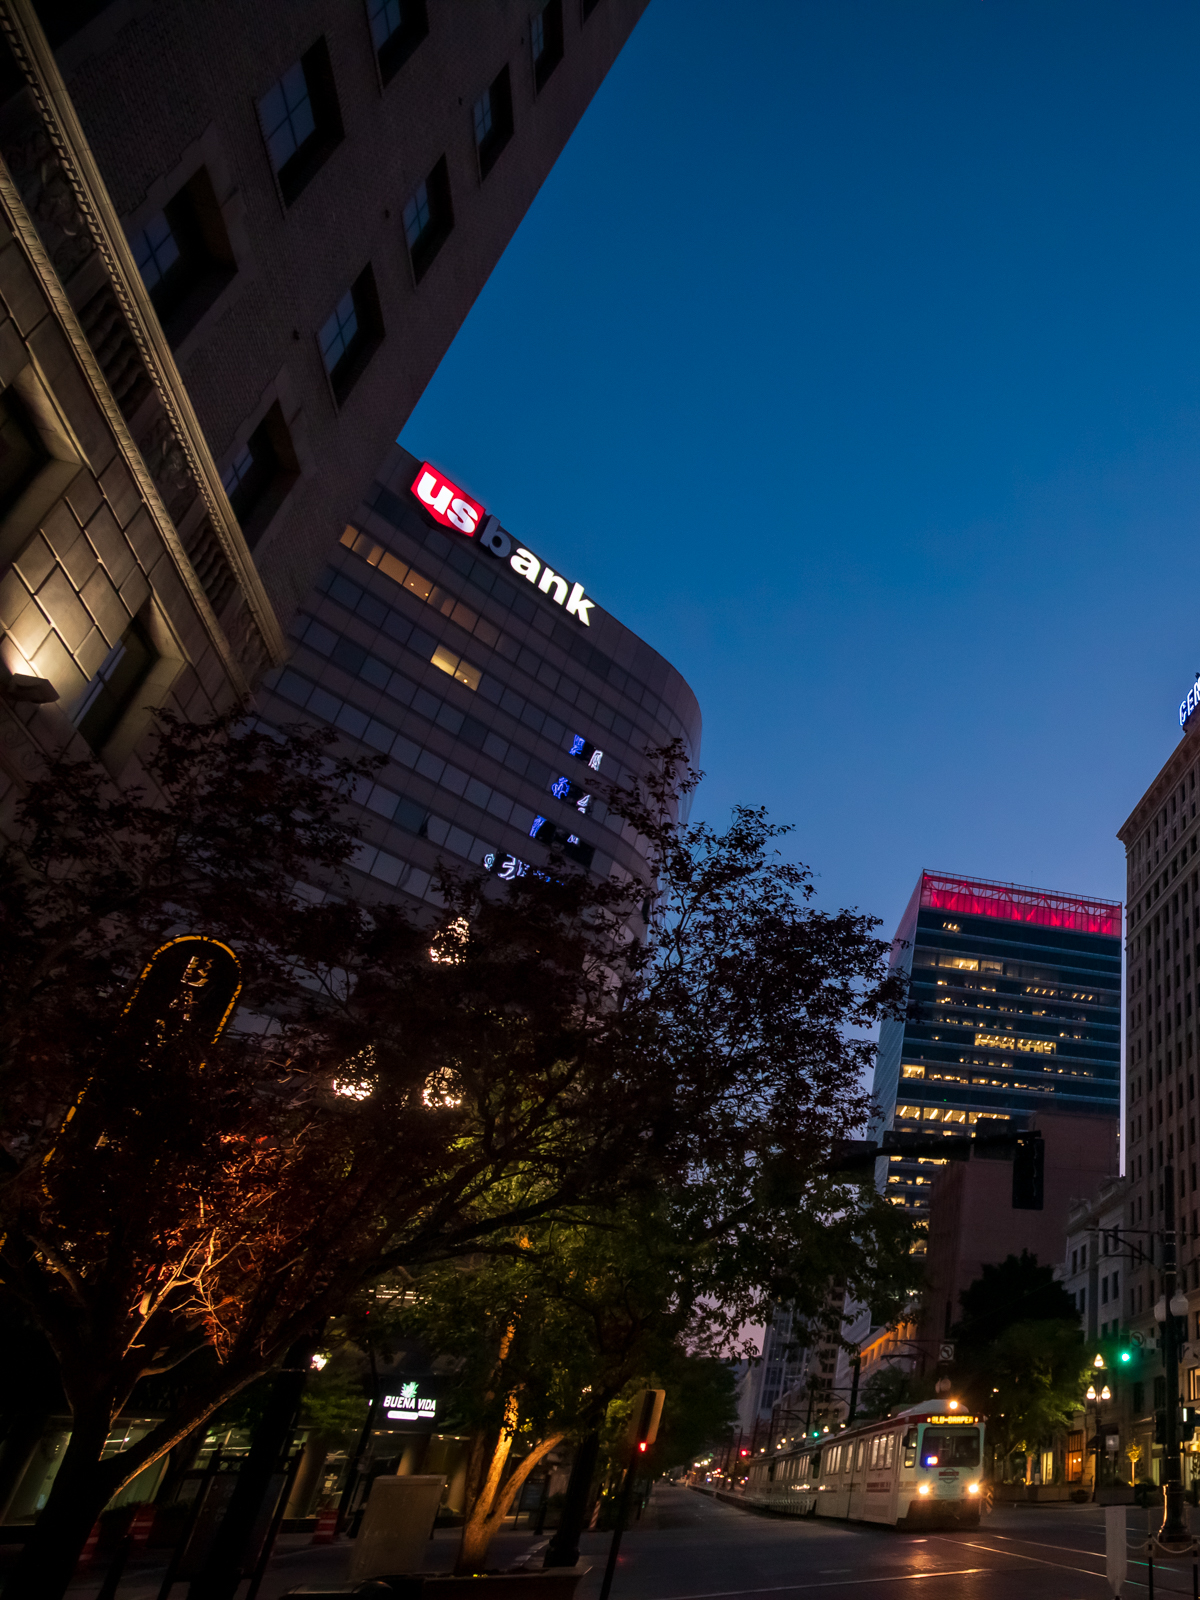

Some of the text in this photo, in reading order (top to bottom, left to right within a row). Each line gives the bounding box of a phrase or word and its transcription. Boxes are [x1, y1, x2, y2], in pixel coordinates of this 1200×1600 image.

[416, 471, 595, 627] us bank
[383, 1395, 436, 1411] BUENA VIDA
